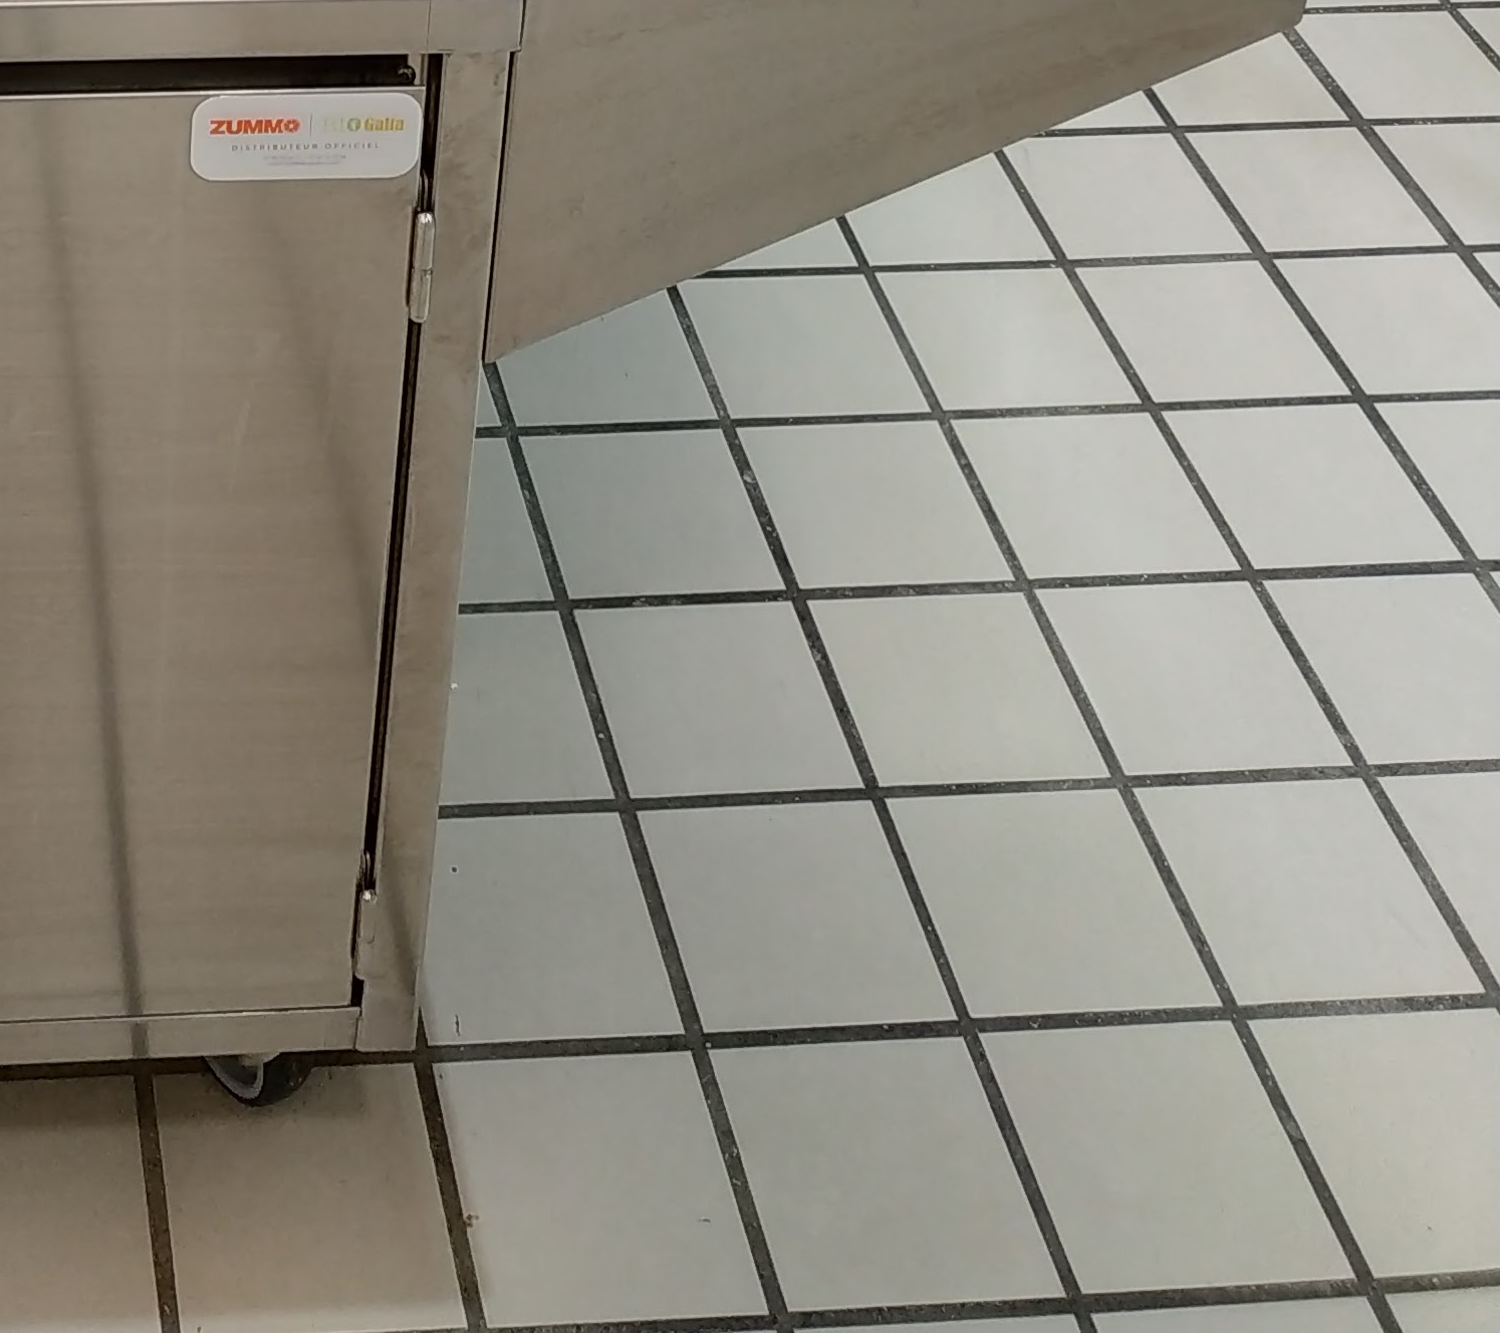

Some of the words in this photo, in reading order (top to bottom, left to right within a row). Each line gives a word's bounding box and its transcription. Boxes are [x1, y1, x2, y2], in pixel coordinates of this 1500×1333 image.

[209, 118, 300, 135] ZUMMO
[231, 142, 319, 152] DISTRIBUTEUR
[324, 142, 380, 150] OFFICIEL
